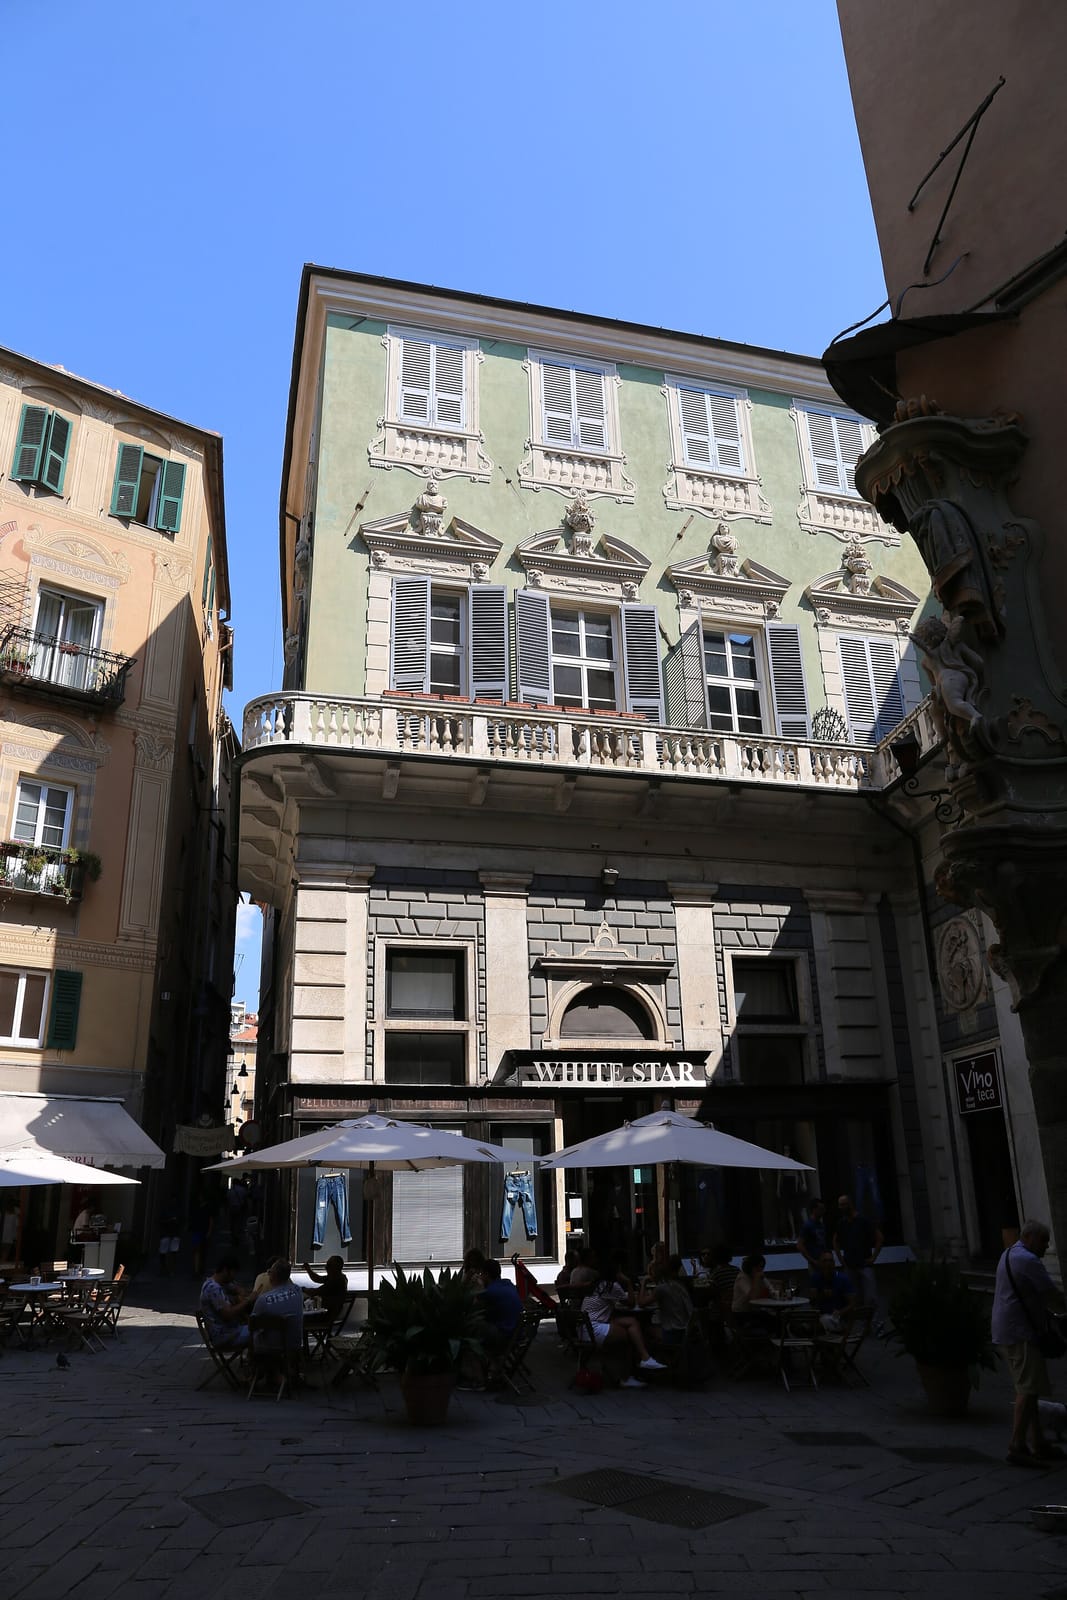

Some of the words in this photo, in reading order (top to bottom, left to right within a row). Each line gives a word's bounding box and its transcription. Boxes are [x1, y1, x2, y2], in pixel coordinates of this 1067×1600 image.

[532, 1061, 624, 1081] WHITE
[632, 1061, 695, 1081] STAR
[977, 1088, 995, 1102] teca
